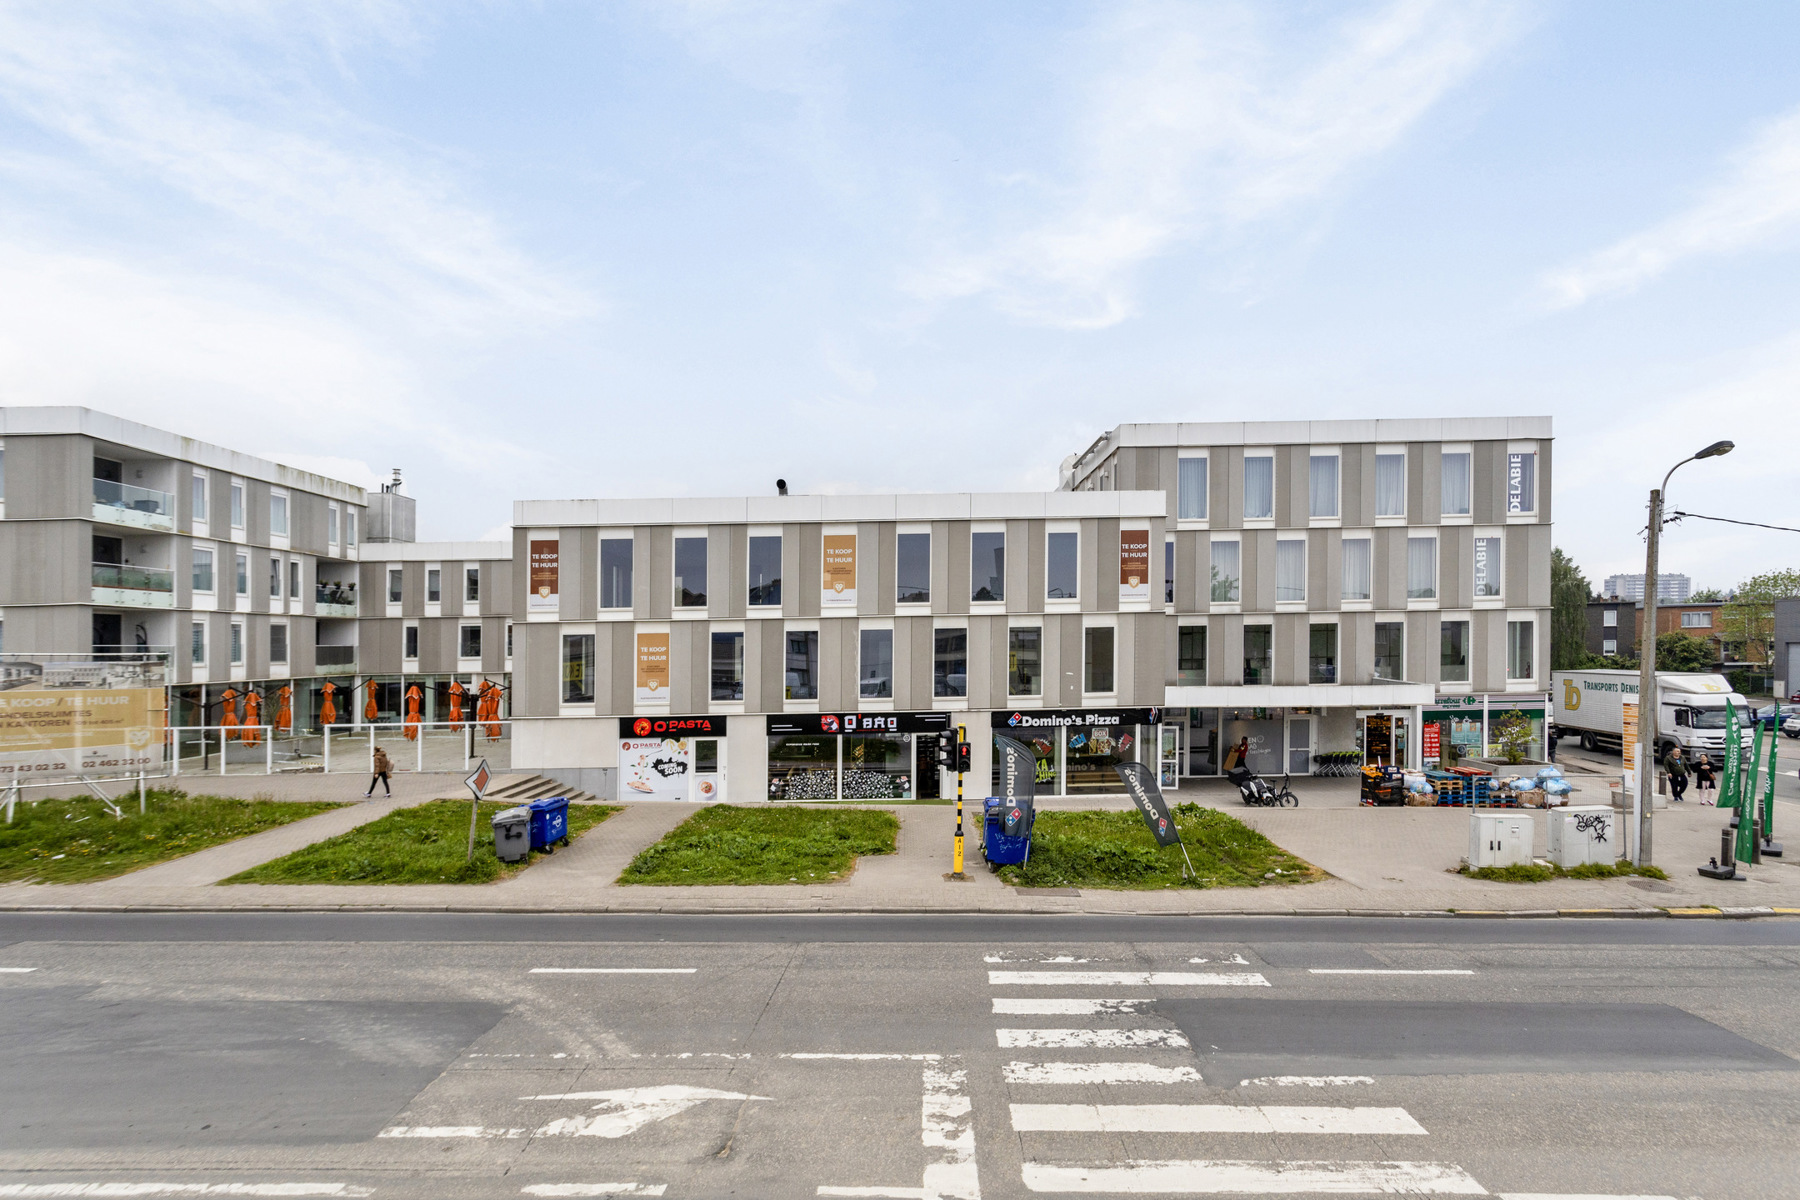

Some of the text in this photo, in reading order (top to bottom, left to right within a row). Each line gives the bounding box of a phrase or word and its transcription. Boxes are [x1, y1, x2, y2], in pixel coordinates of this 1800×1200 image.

[1510, 454, 1522, 512] DELABIE
[1476, 539, 1486, 595] DELABIE
[1584, 681, 1618, 692] TRANSPORTS
[11, 698, 56, 707] KOOP
[65, 697, 83, 706] TE
[87, 696, 129, 705] HUUR
[6, 719, 70, 728] KANTOREN
[1022, 714, 1119, 727] Domino's Pizza
[35, 763, 49, 771] 02
[52, 762, 66, 770] 32
[664, 766, 683, 775] SOON
